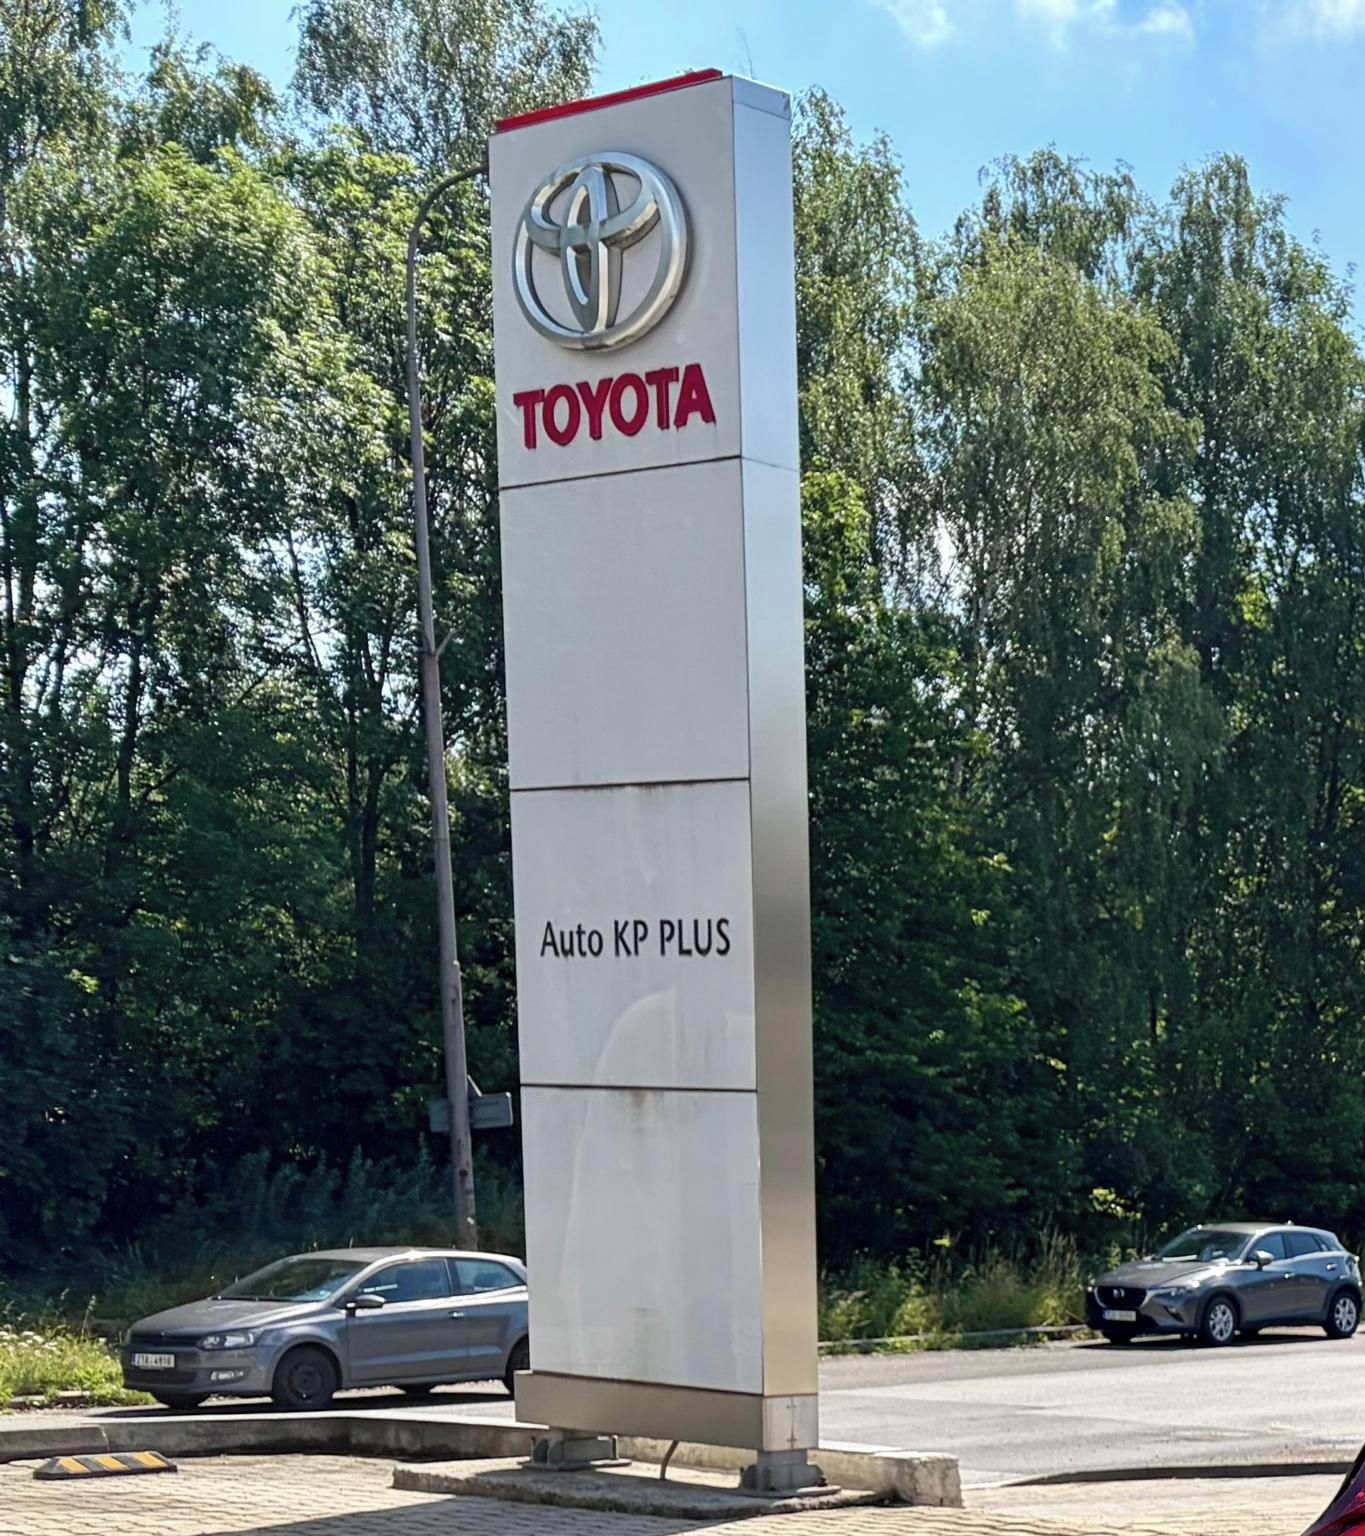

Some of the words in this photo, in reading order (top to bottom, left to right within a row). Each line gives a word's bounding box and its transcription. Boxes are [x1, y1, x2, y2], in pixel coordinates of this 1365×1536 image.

[513, 363, 716, 450] TOYOTA
[540, 921, 604, 957] Auto
[614, 920, 648, 957] KP
[660, 918, 731, 957] PLUS
